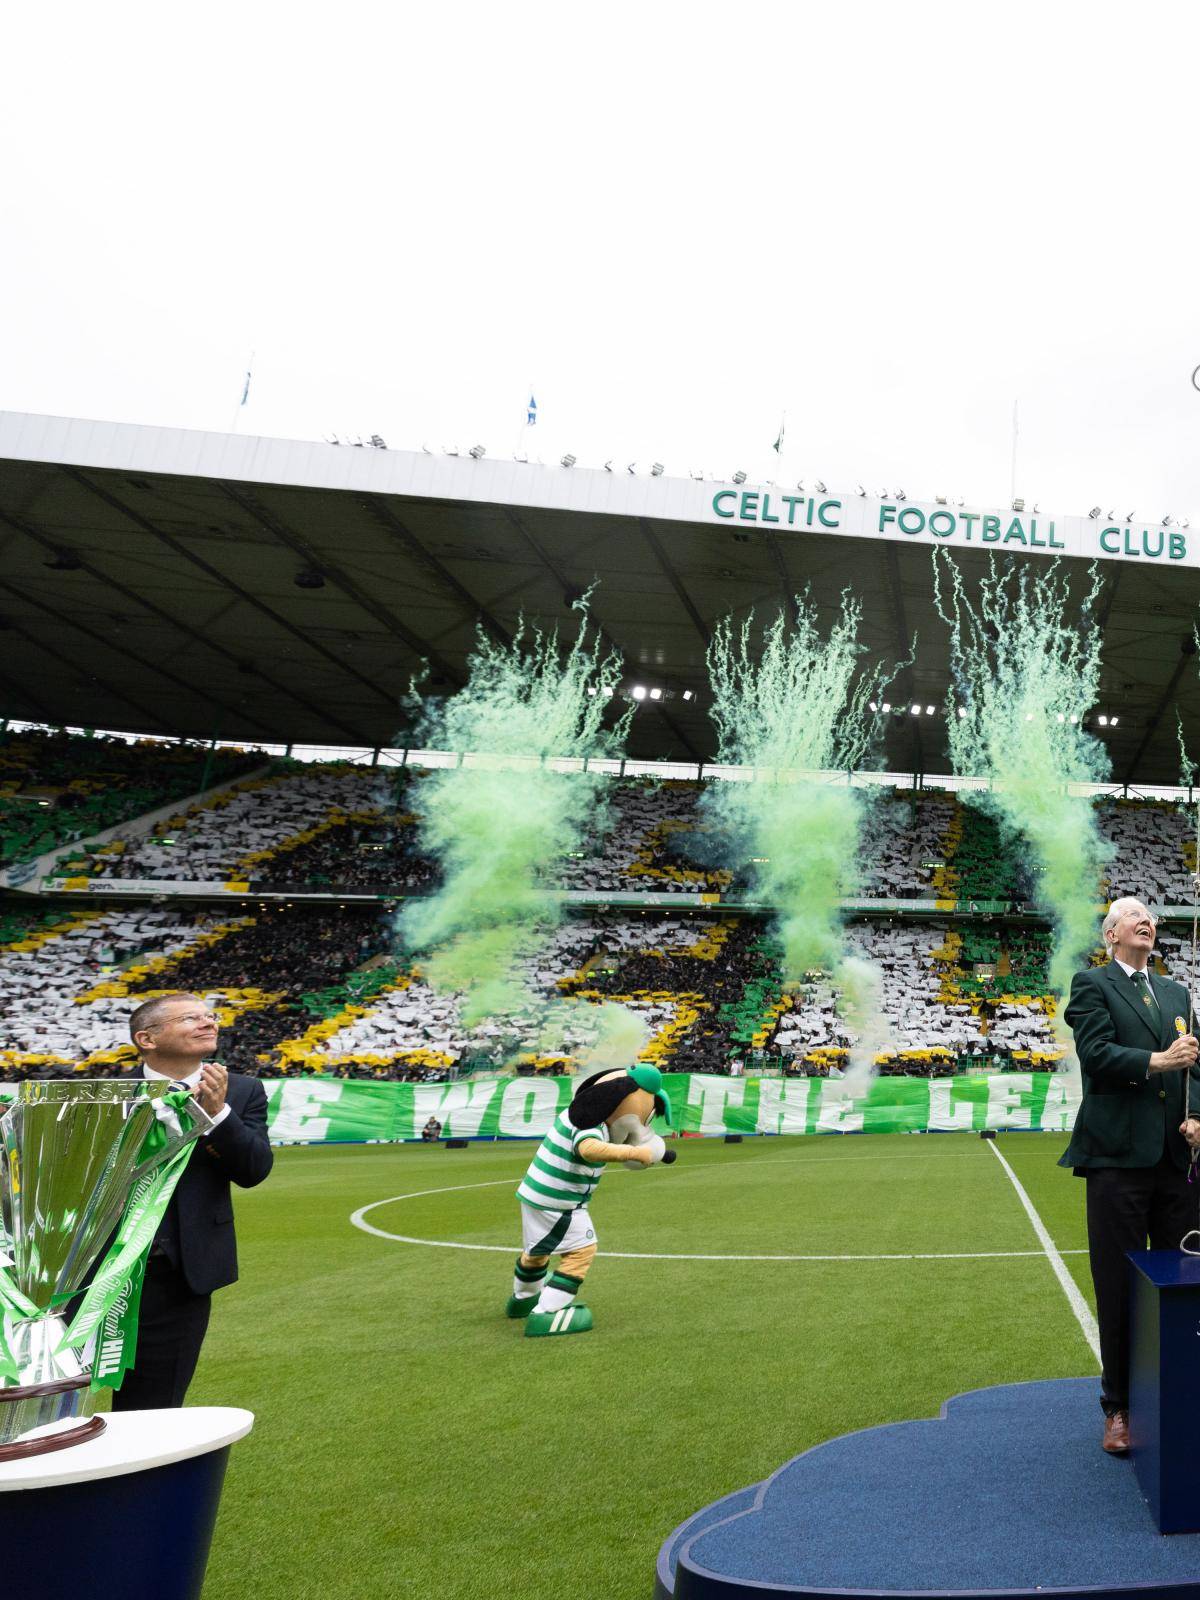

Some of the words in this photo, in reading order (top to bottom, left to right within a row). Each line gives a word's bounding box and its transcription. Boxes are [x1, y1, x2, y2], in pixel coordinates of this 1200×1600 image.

[712, 490, 842, 527] CELTIC
[878, 505, 1065, 549] FOOTBALL
[1099, 527, 1188, 560] CLUB
[687, 1074, 868, 1134] THE
[98, 1339, 124, 1378] HILL
